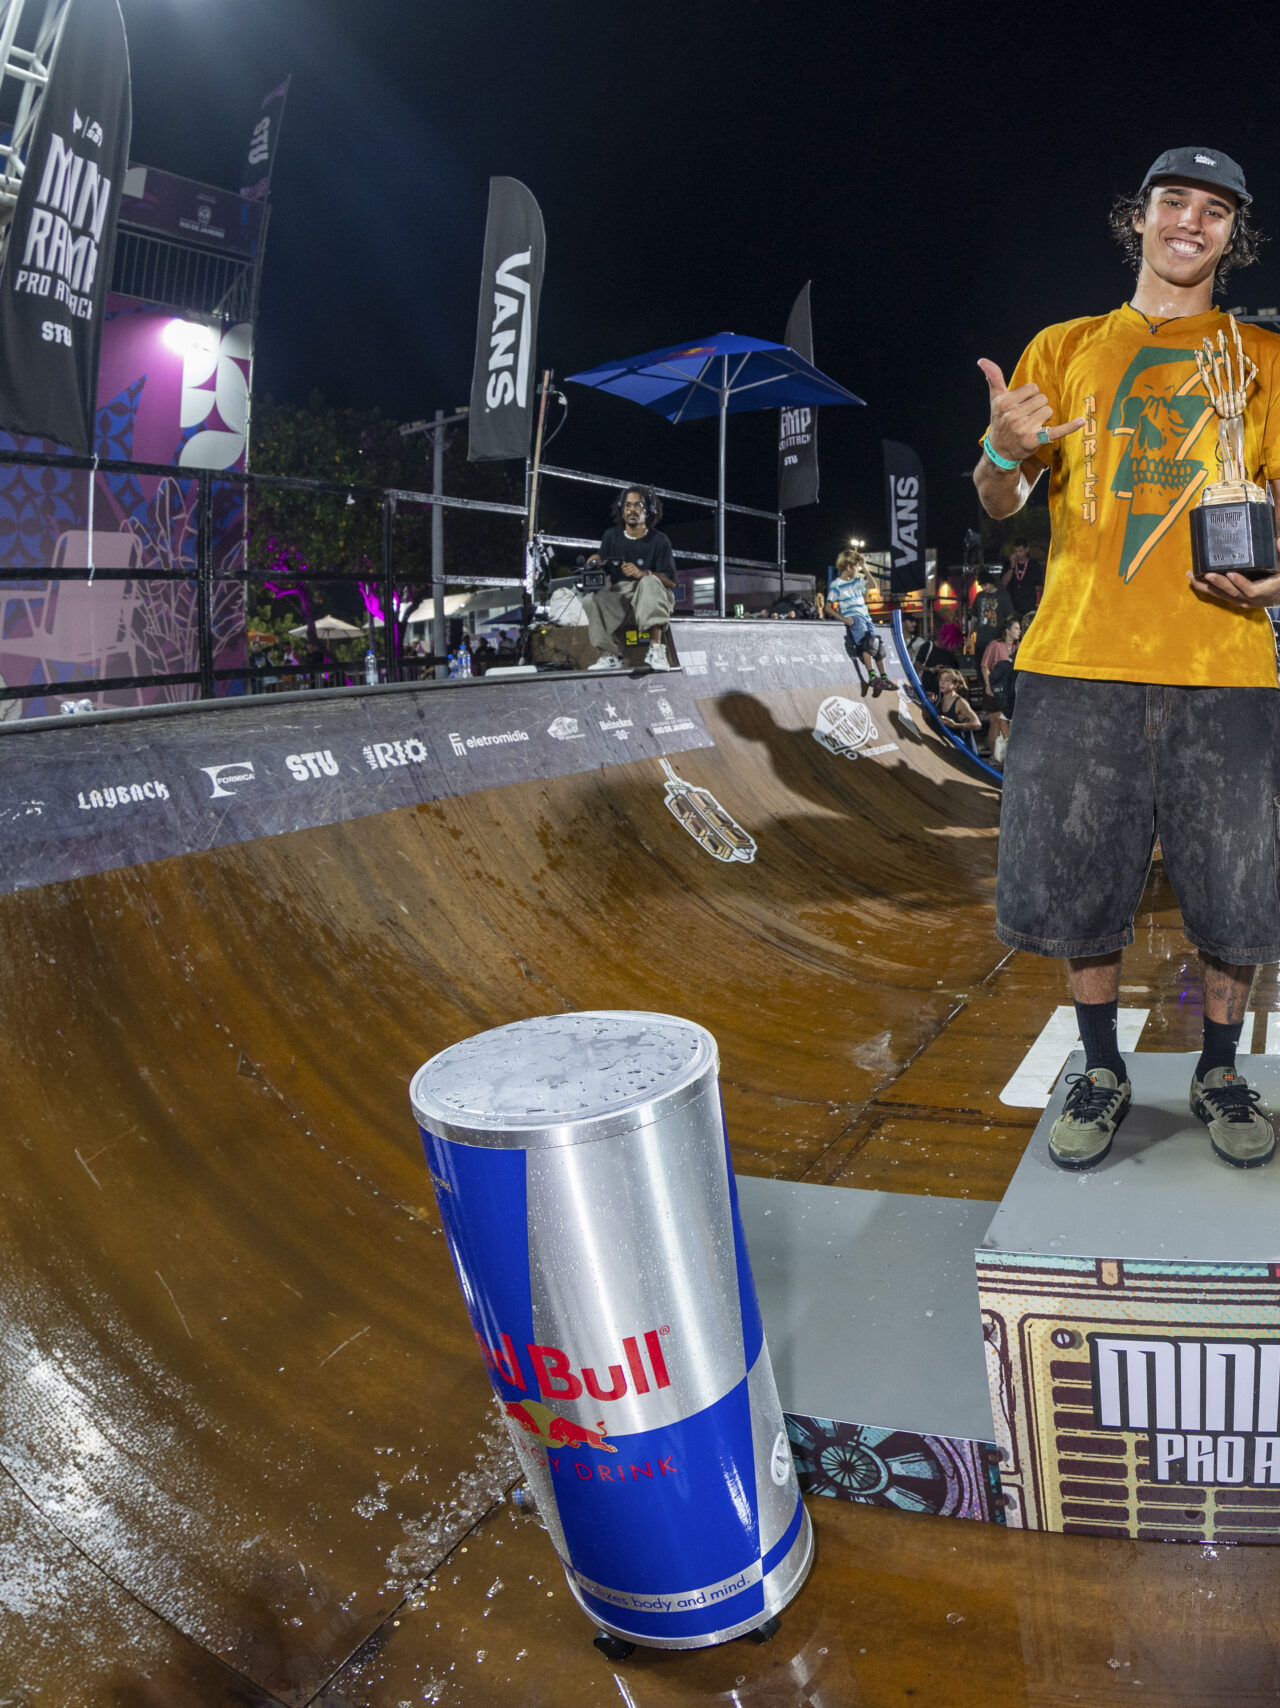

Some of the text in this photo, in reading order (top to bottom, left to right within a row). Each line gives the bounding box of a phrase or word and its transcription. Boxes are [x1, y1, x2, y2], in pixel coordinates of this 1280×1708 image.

[249, 116, 270, 164] STU
[36, 132, 111, 243] MIN
[14, 270, 52, 296] PRO
[41, 321, 73, 347] STU
[484, 244, 533, 410] VANS
[780, 407, 811, 440] AMP
[784, 454, 798, 466] STU
[888, 474, 921, 568] VANS
[363, 738, 428, 770] visit RIO
[466, 729, 530, 749] eletromidia
[216, 773, 256, 786] FORMICA
[285, 750, 340, 781] STU
[77, 780, 170, 810] LAYBACK
[574, 1455, 678, 1483] DRINK
[1156, 1434, 1244, 1483] PRO
[631, 1595, 672, 1612] body
[677, 1592, 707, 1609] and
[710, 1574, 750, 1601] mind.
